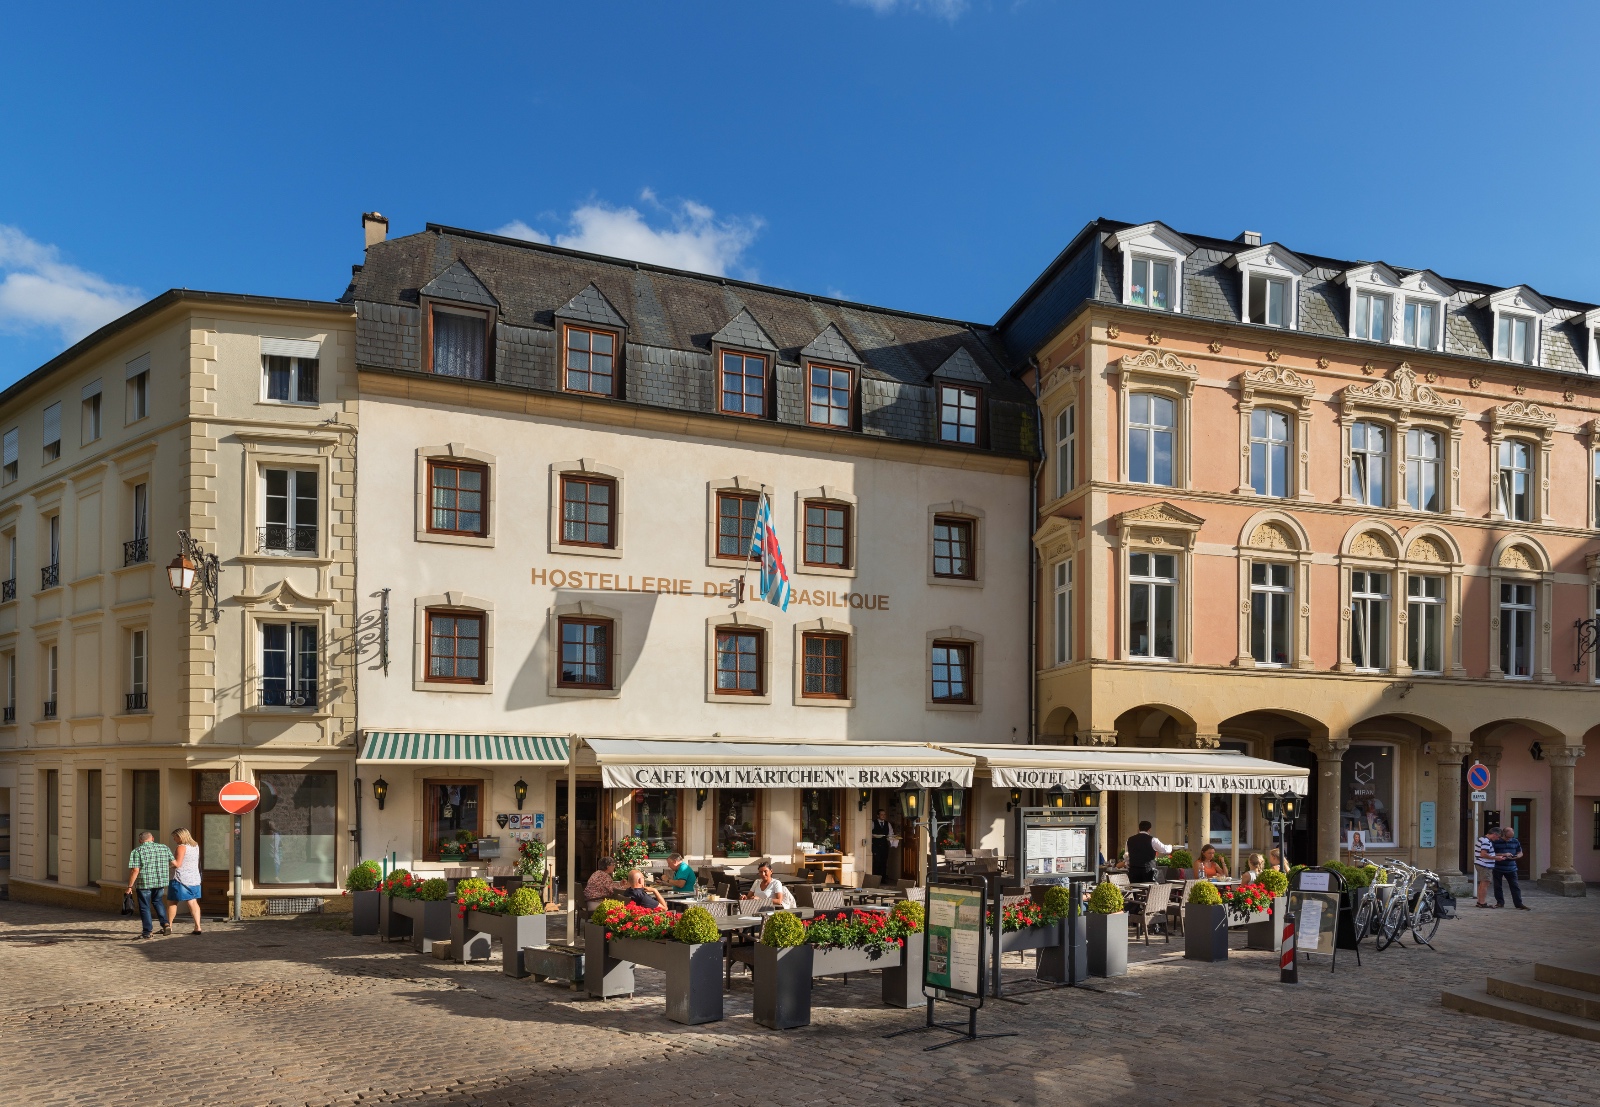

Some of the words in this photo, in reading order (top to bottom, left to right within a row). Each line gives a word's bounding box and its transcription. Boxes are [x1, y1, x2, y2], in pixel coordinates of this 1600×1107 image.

[531, 568, 692, 596] HOSTELLERIE
[703, 581, 732, 599] DE
[788, 588, 890, 611] BASILIQUE
[635, 769, 686, 784] CAFE
[691, 769, 731, 784] "OM
[735, 767, 844, 784] MÄRTCHEN"
[858, 769, 947, 783] BRASSERIE
[1078, 772, 1170, 787] RESTAURANT
[1175, 776, 1193, 788] DE
[1199, 777, 1216, 789] LA
[1221, 777, 1288, 791] BASILIQUE
